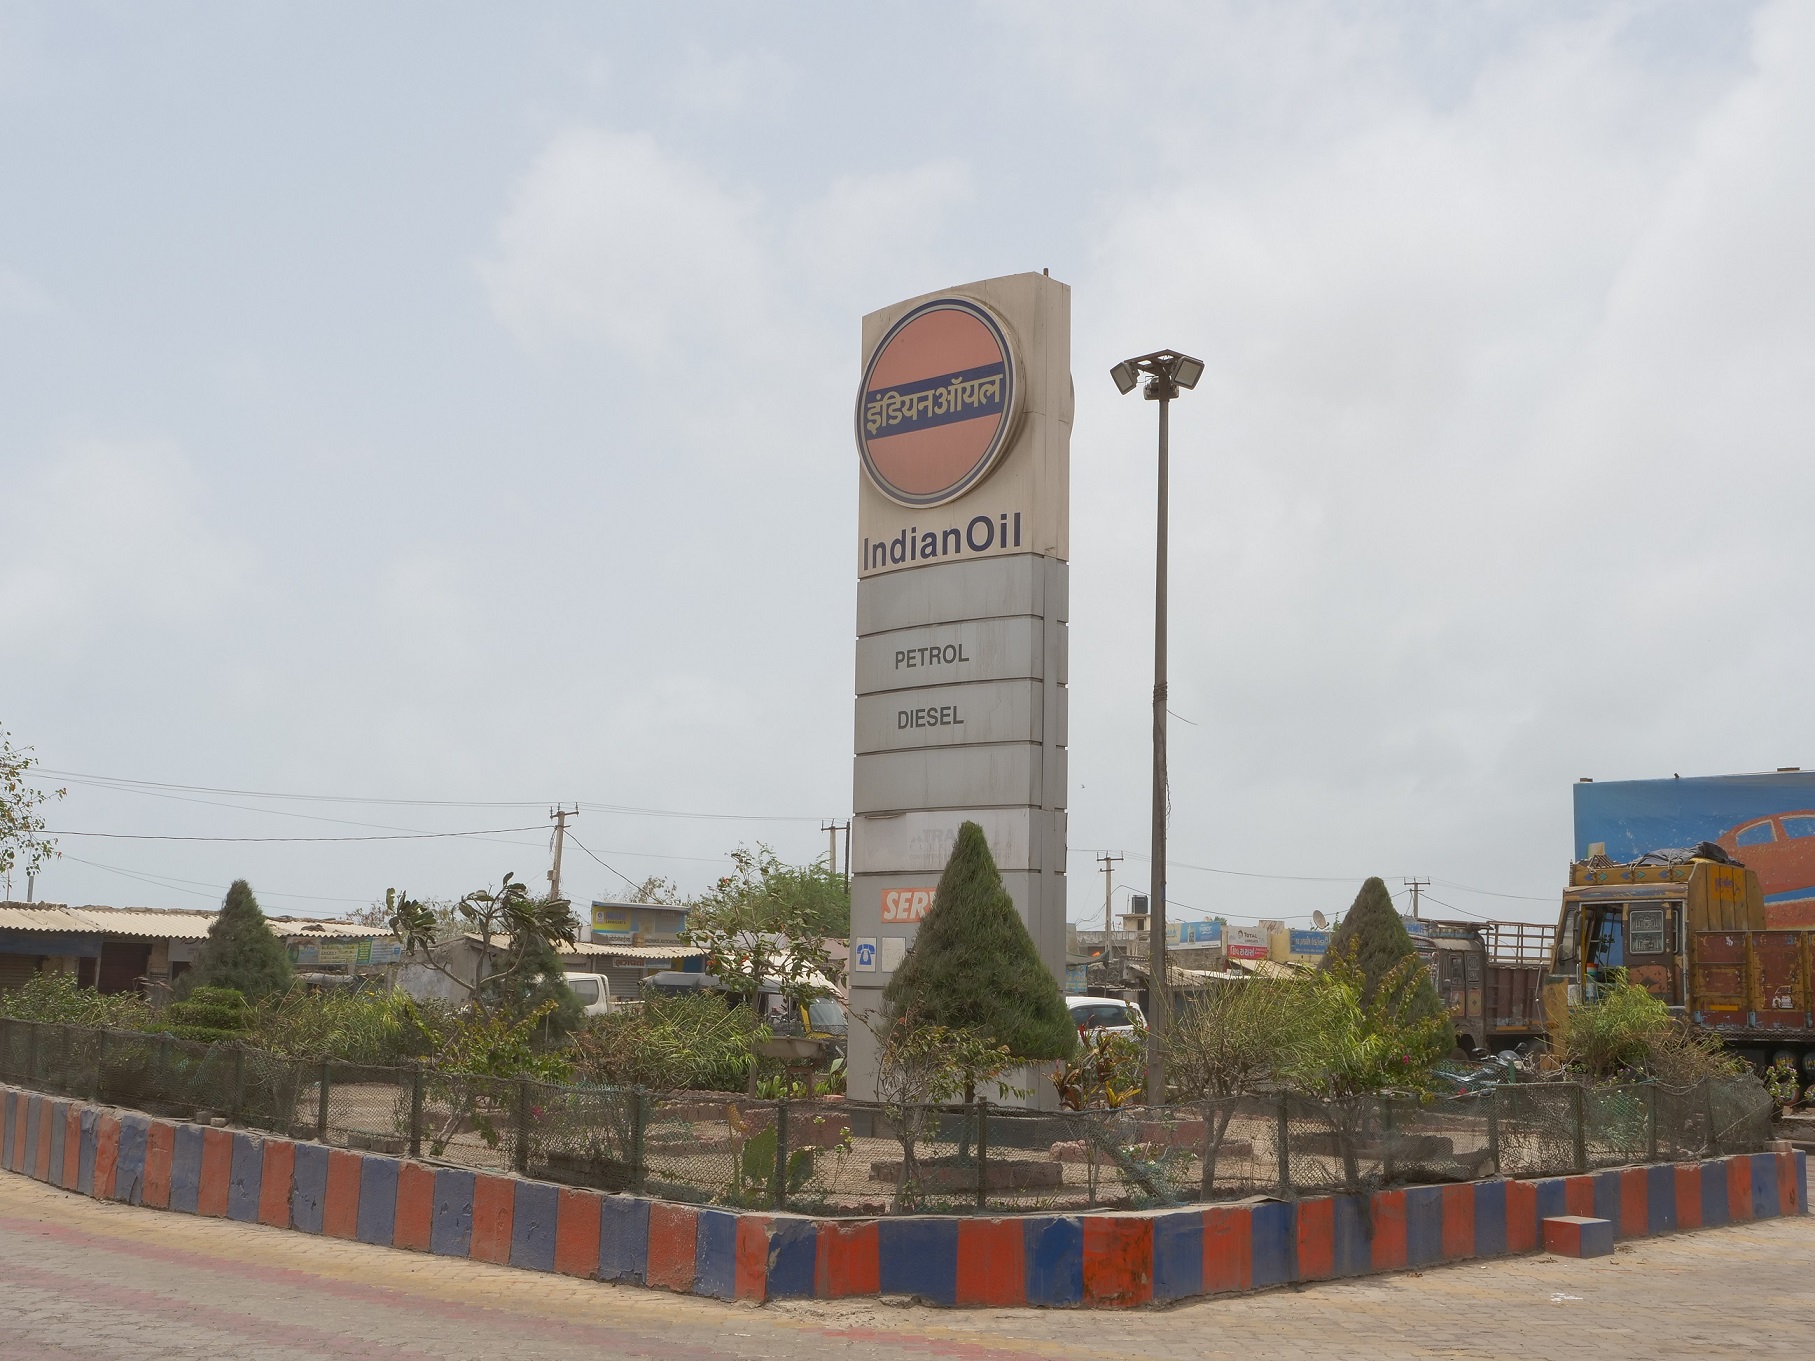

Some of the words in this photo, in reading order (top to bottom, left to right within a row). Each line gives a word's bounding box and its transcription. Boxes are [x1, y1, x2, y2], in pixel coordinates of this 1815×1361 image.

[866, 374, 1003, 435] इंडियनऑयल
[863, 512, 1021, 571] IndianOil
[895, 643, 970, 669] PETROL
[897, 705, 964, 730] DIESEL
